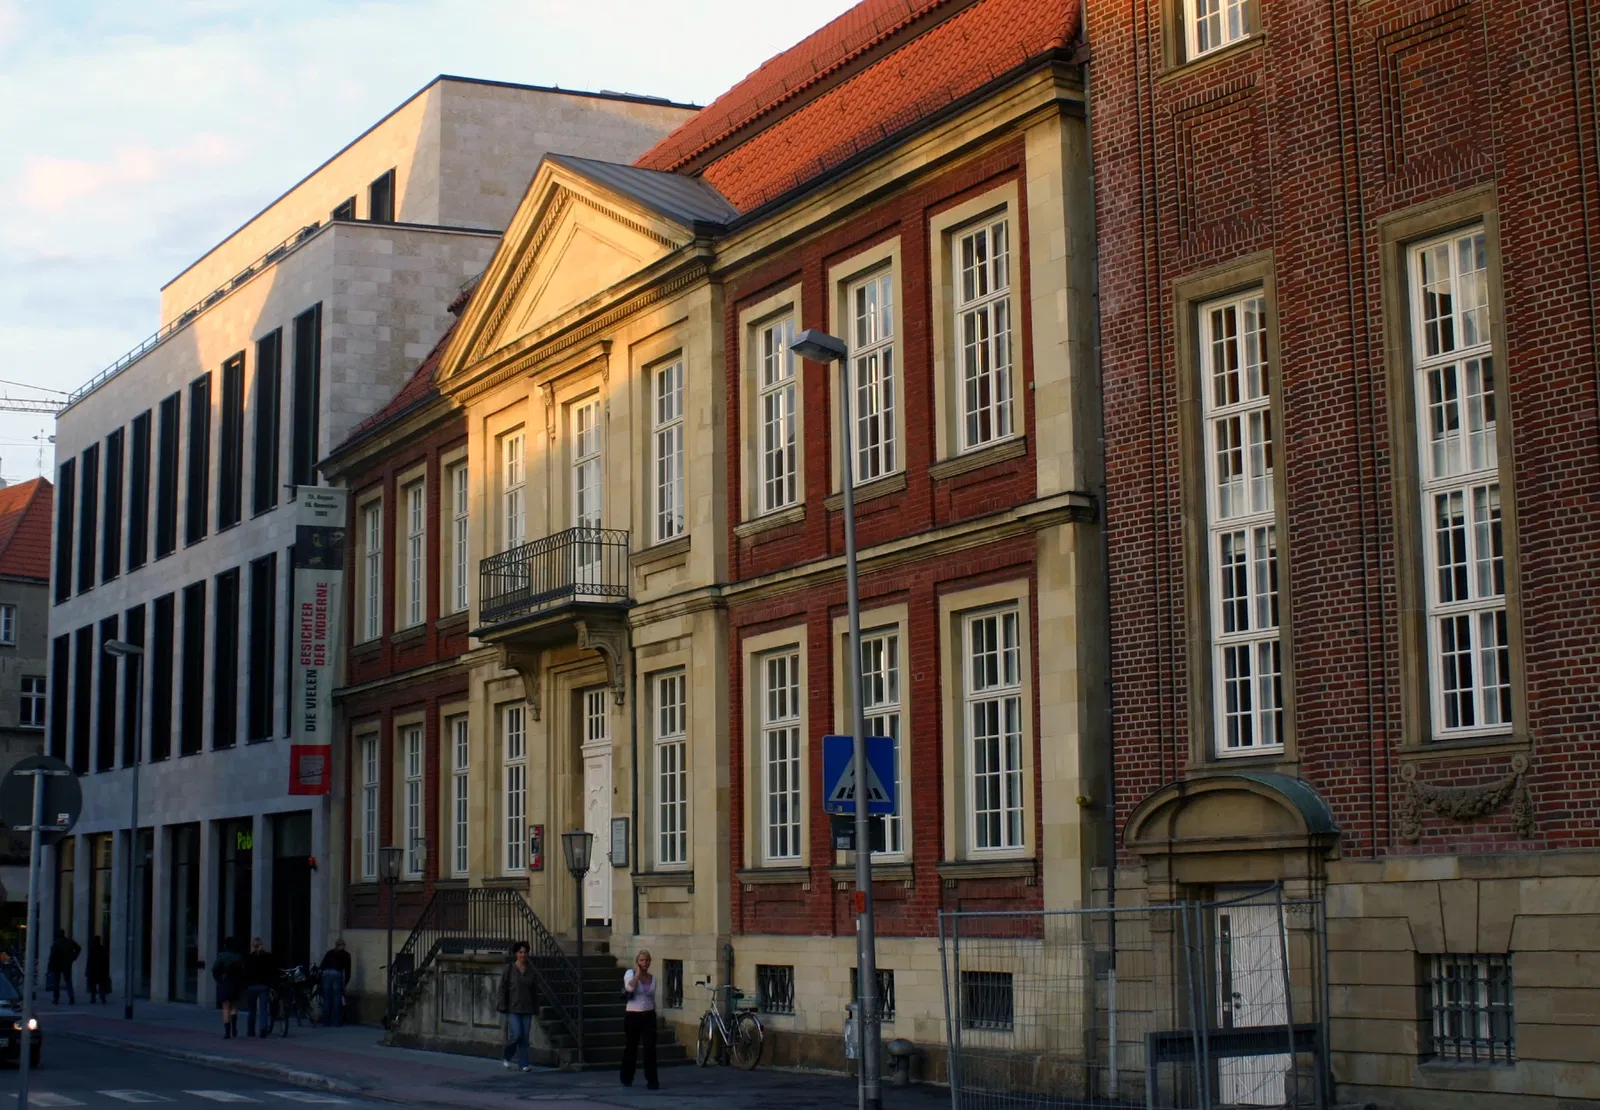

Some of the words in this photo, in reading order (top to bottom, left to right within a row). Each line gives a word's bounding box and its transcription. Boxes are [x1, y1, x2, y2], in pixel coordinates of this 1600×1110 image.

[315, 582, 327, 640] MODERNE
[300, 603, 313, 665] GESICHTER
[314, 644, 325, 666] DER
[306, 669, 317, 709] VIELEN
[305, 714, 316, 732] DIE
